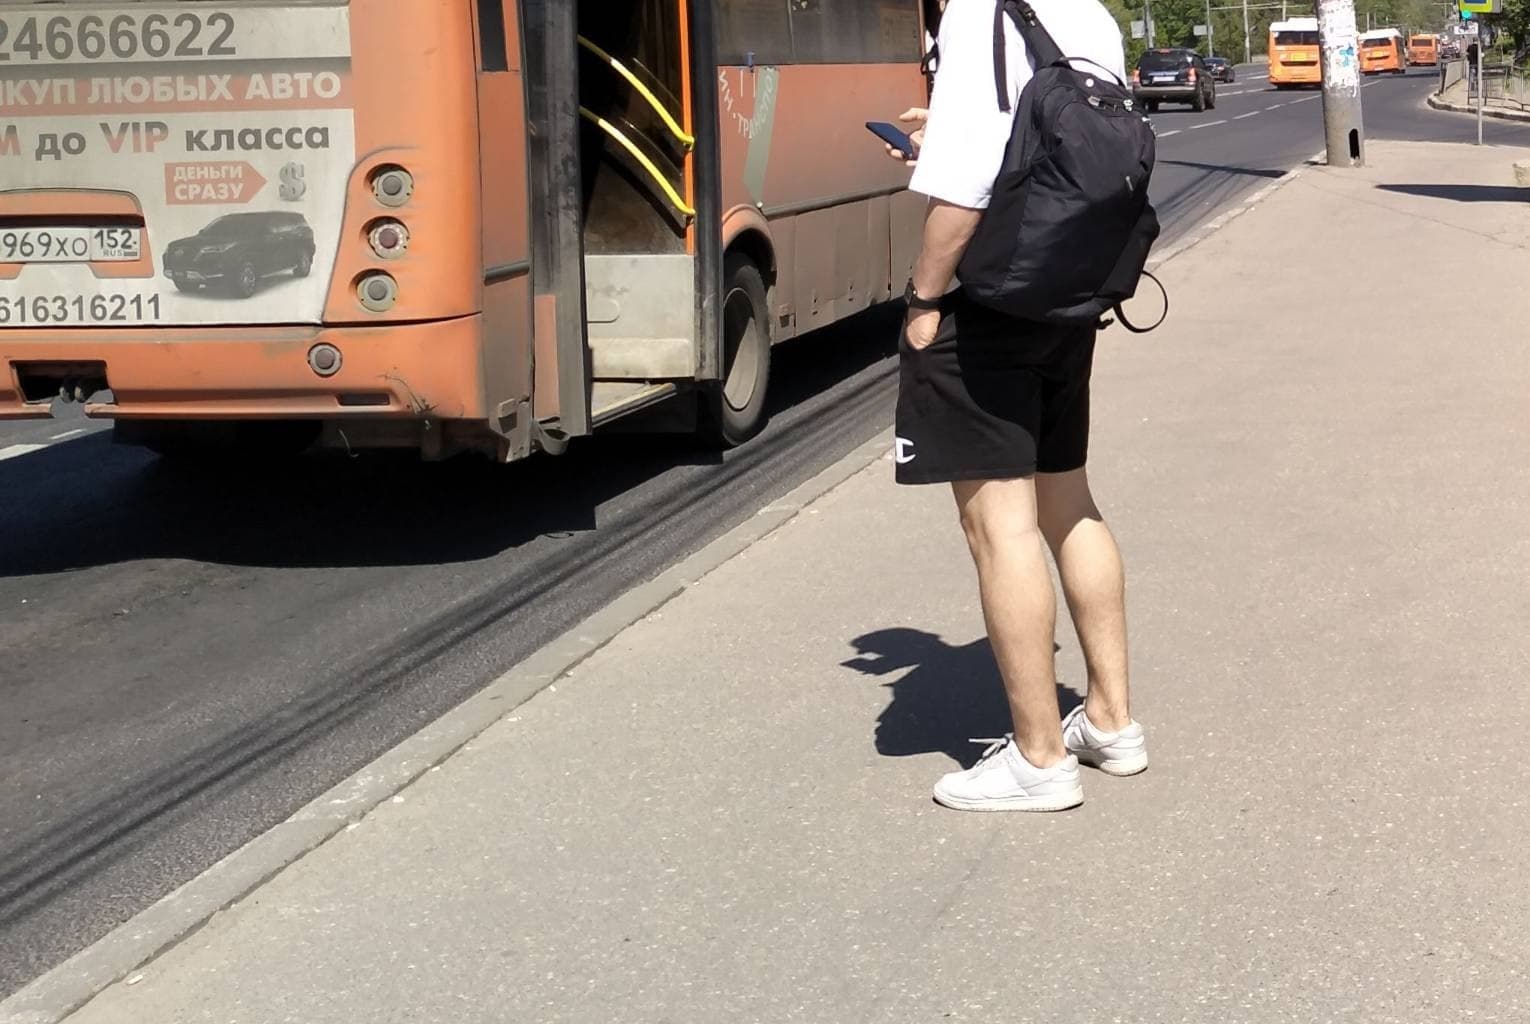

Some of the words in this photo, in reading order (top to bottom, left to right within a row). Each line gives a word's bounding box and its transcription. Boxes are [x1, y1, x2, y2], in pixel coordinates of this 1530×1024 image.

[0, 77, 76, 106] КУП
[88, 74, 234, 104] ЛЮБЫХ
[245, 72, 341, 100] АВТО
[35, 132, 87, 161] до
[99, 121, 169, 154] VIP
[185, 125, 330, 152] класса
[173, 165, 243, 183] ДЕНЬГИ
[174, 182, 244, 201] СРАЗУ
[94, 229, 132, 249] 152
